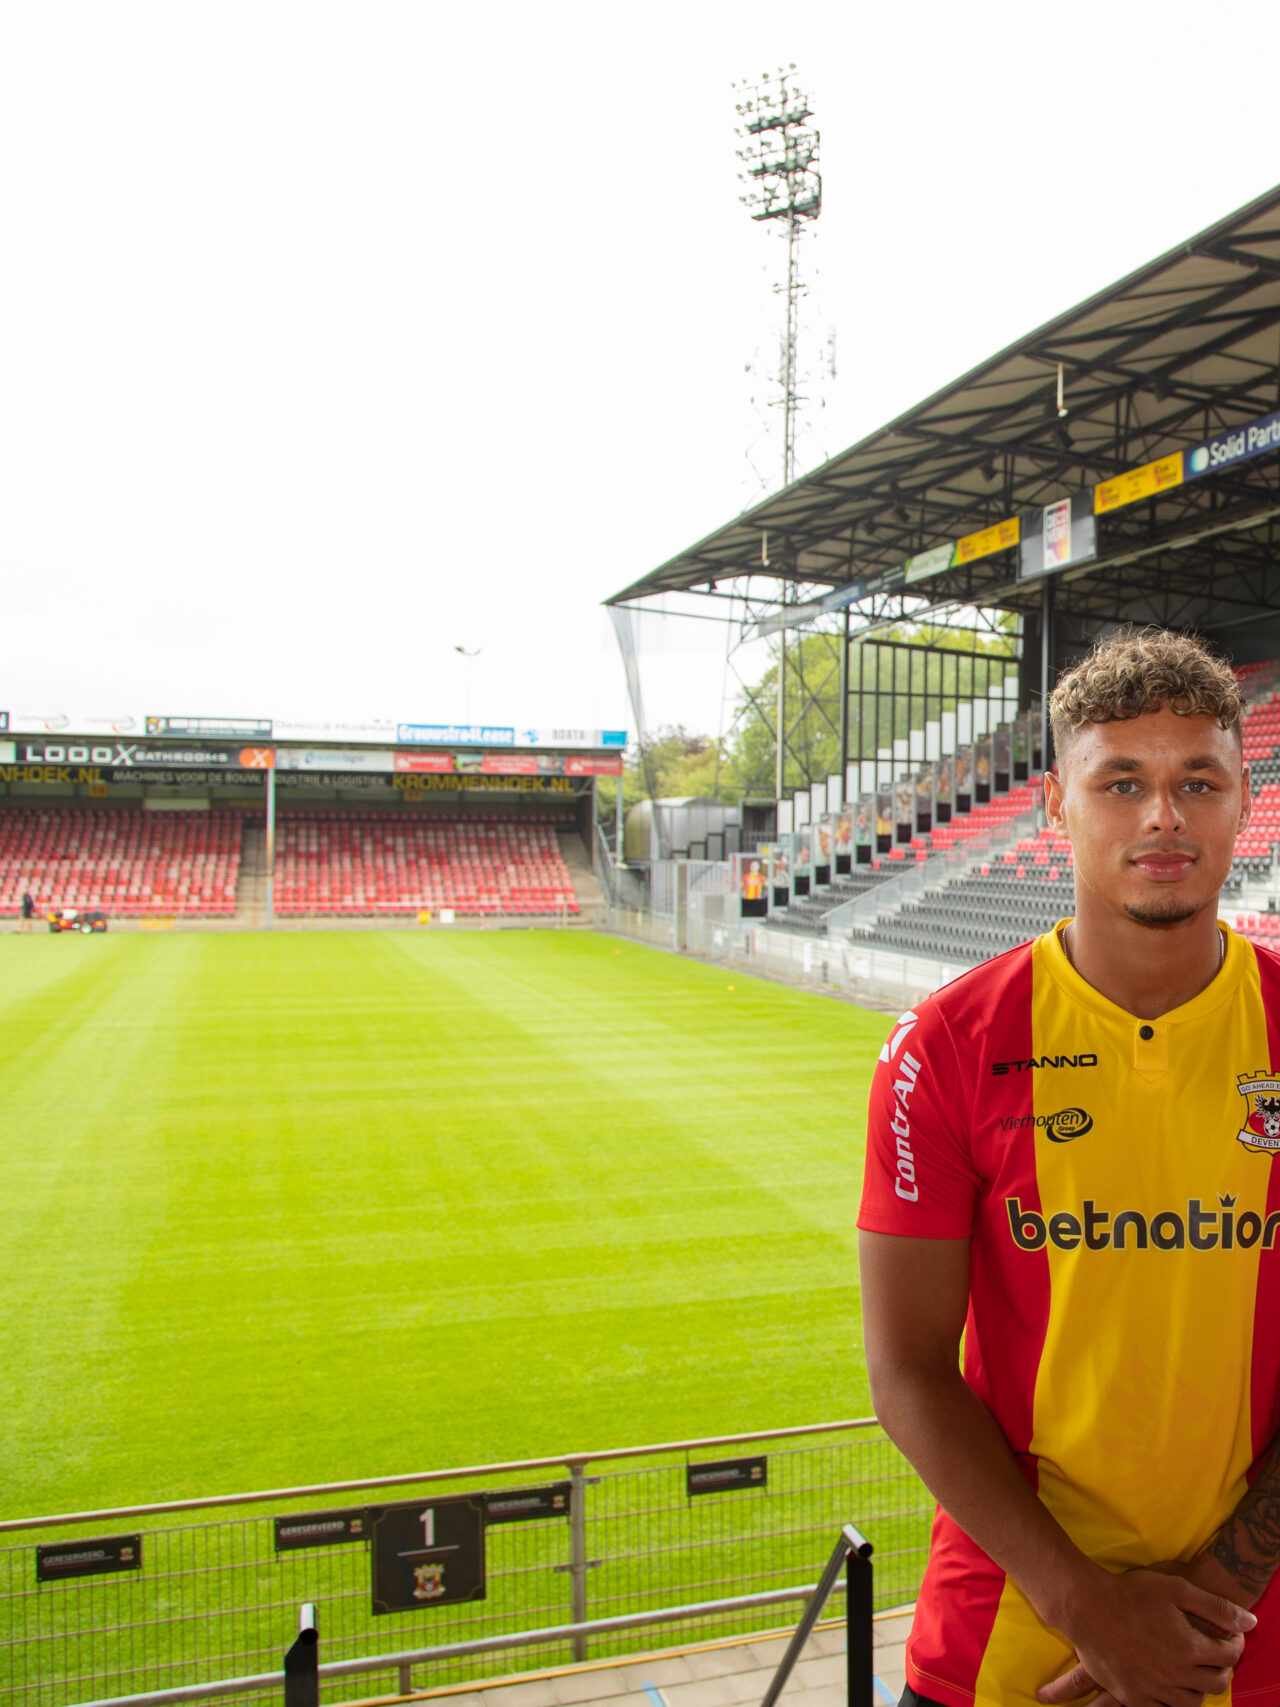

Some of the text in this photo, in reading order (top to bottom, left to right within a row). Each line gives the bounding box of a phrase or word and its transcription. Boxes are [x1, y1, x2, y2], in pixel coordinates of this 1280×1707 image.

[1210, 428, 1245, 466] Solid
[135, 752, 229, 763] BATHROOMS
[113, 771, 174, 782] MACHINES
[175, 772, 205, 783] VOOR
[208, 773, 223, 783] DE
[265, 774, 320, 785] IDUSTRIE
[332, 775, 386, 786] LOGISTIEK
[392, 774, 575, 792] KROMMENHOEK.NL
[992, 1053, 1098, 1076] STANNO
[1240, 1085, 1251, 1093] GO
[1253, 1082, 1275, 1090] AHEAD
[1000, 1113, 1080, 1131] Vierhouten
[419, 1508, 436, 1547] 1
